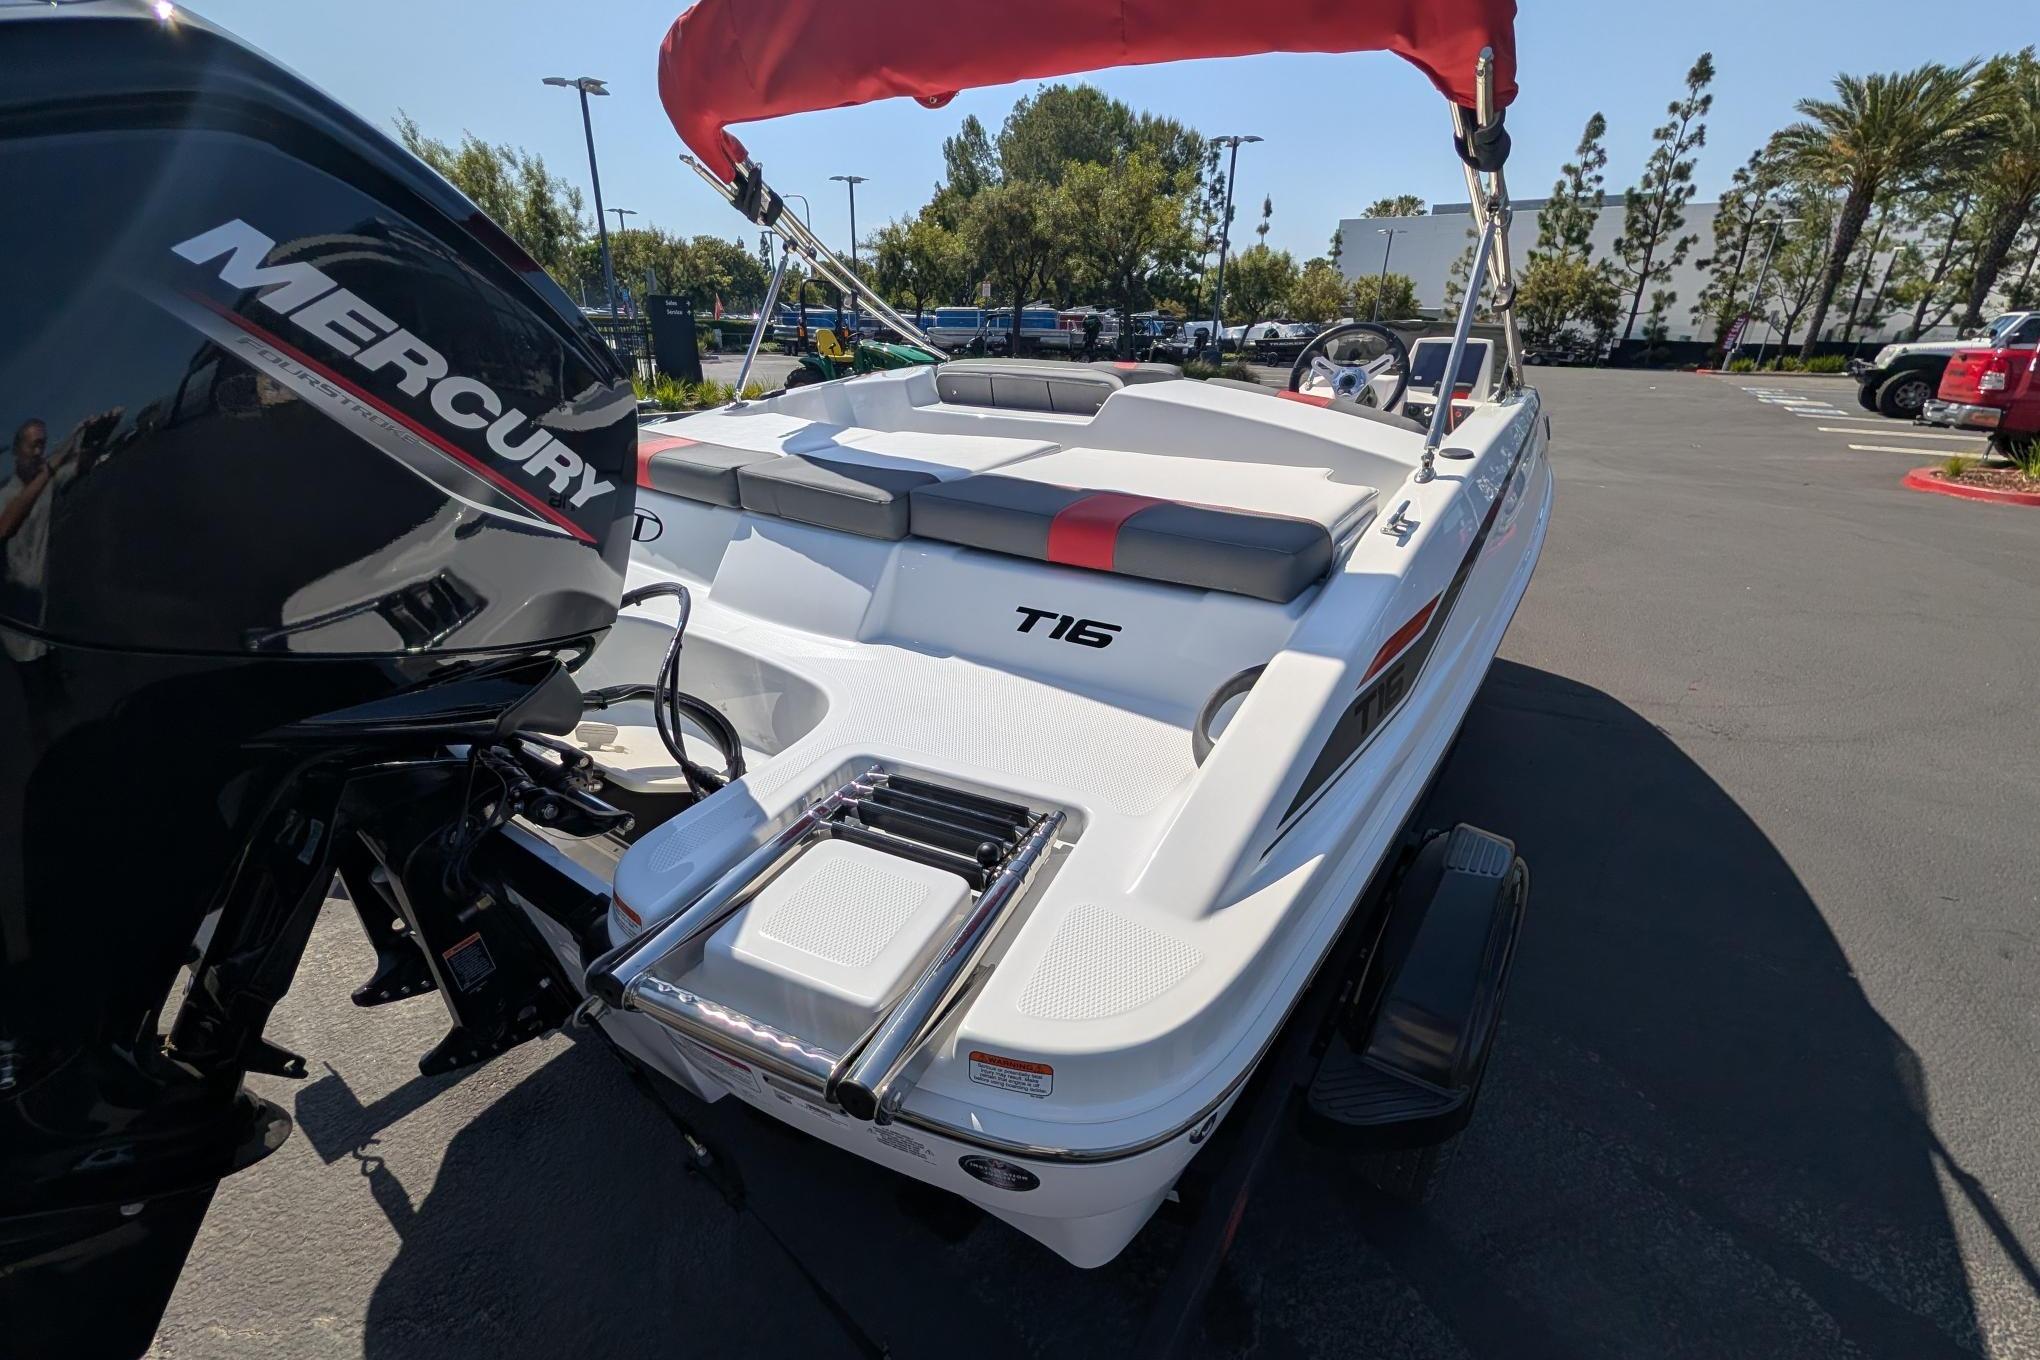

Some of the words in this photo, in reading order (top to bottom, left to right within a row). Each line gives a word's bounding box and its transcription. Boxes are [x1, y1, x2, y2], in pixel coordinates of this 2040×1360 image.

[171, 218, 616, 508] MERCURY
[235, 335, 417, 445] FOURSTROKE
[1016, 606, 1123, 649] T16
[1354, 662, 1406, 736] T16
[988, 1057, 1033, 1070] WARNING
